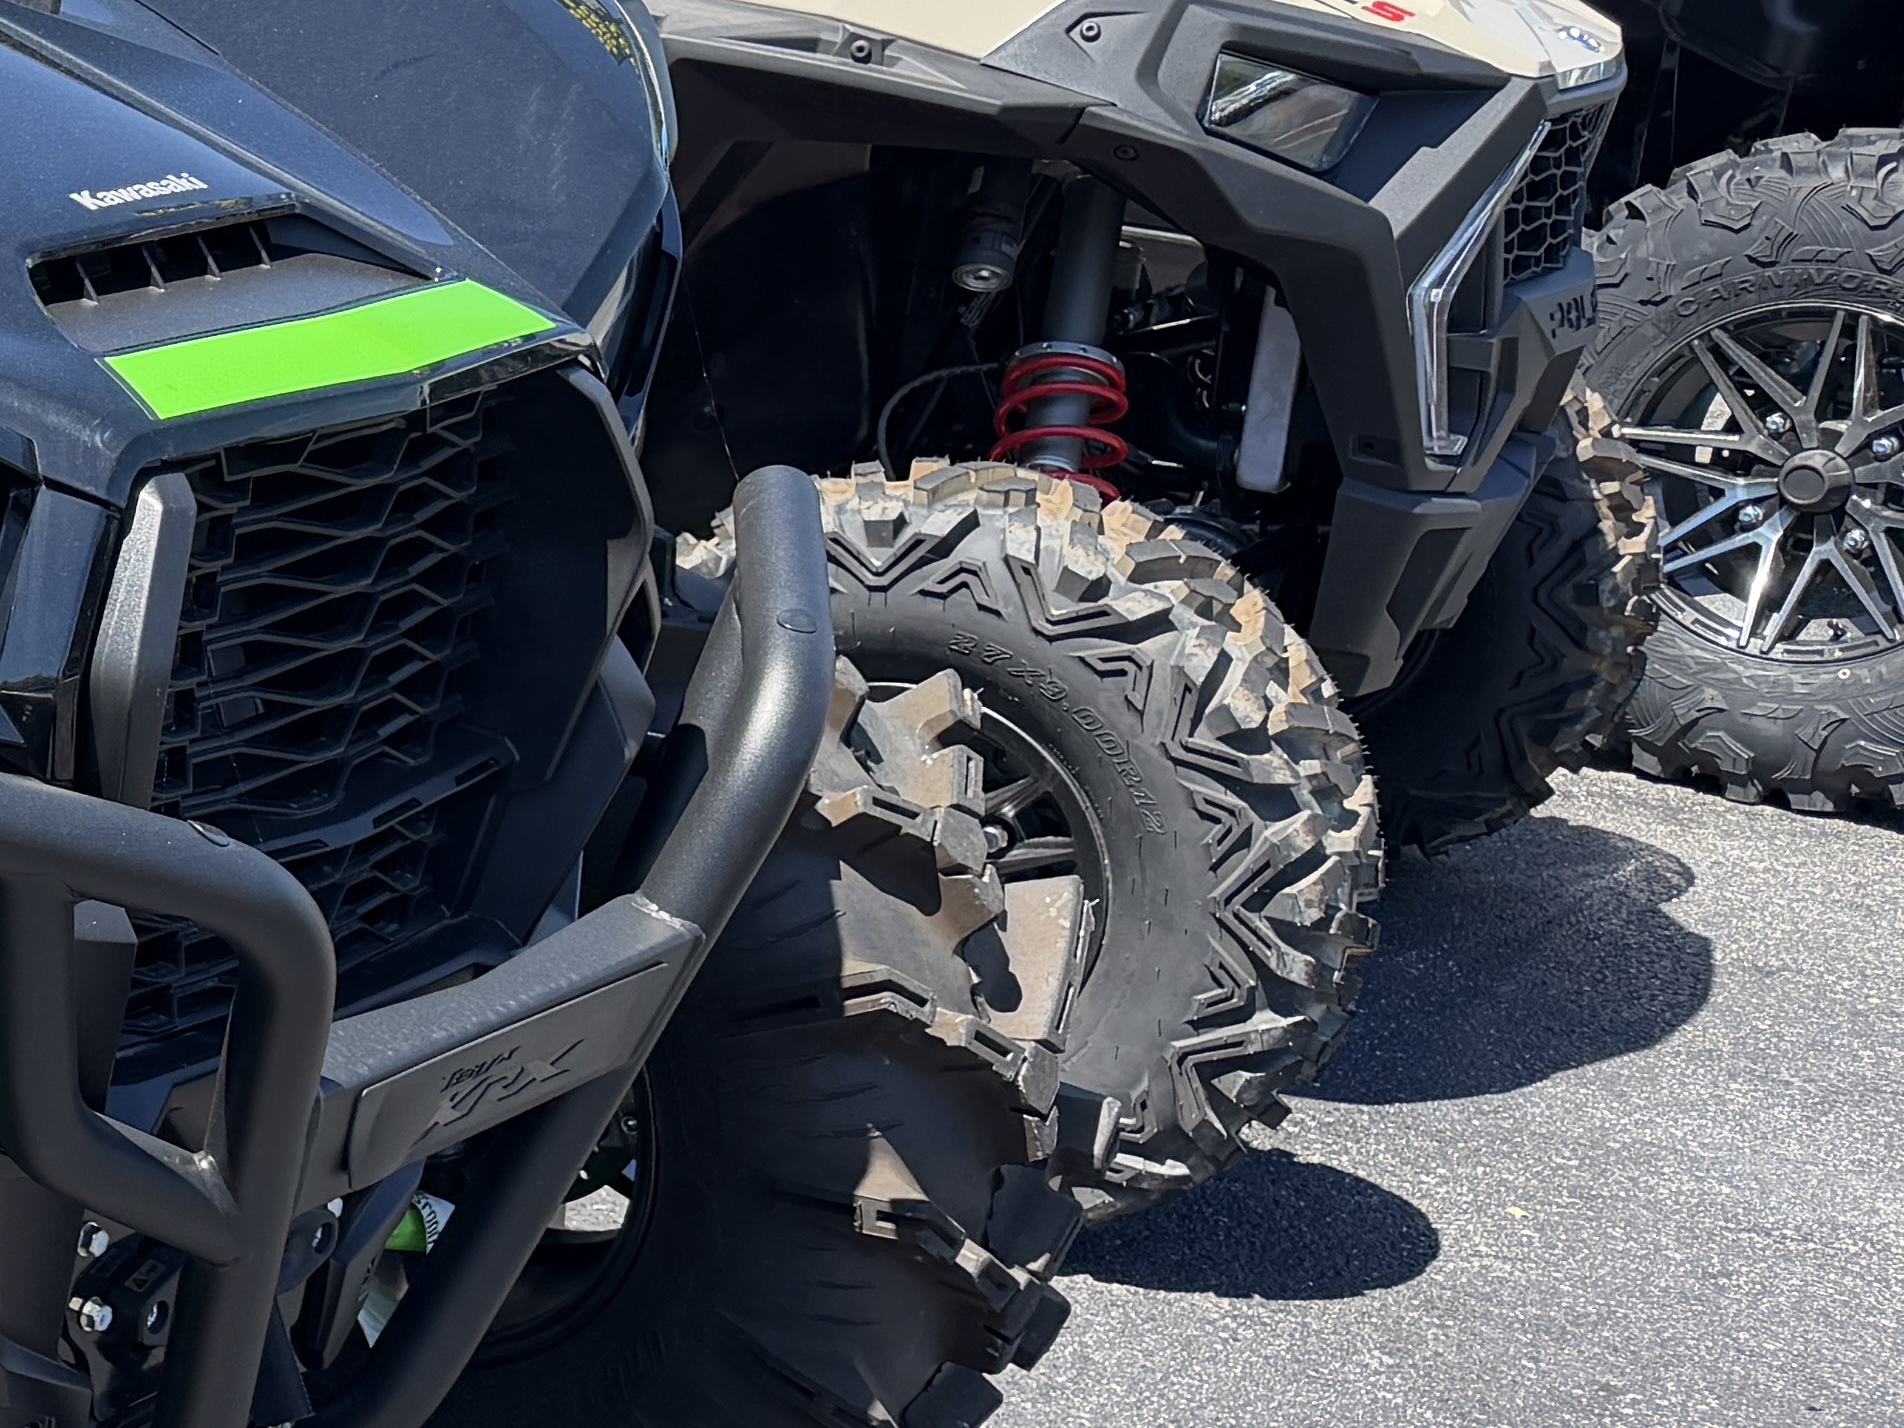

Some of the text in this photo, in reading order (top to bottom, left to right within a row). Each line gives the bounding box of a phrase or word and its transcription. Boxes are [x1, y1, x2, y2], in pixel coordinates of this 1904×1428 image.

[1360, 0, 1416, 22] S
[68, 172, 209, 211] Kawasaki
[1675, 266, 1904, 318] CARNIVOR
